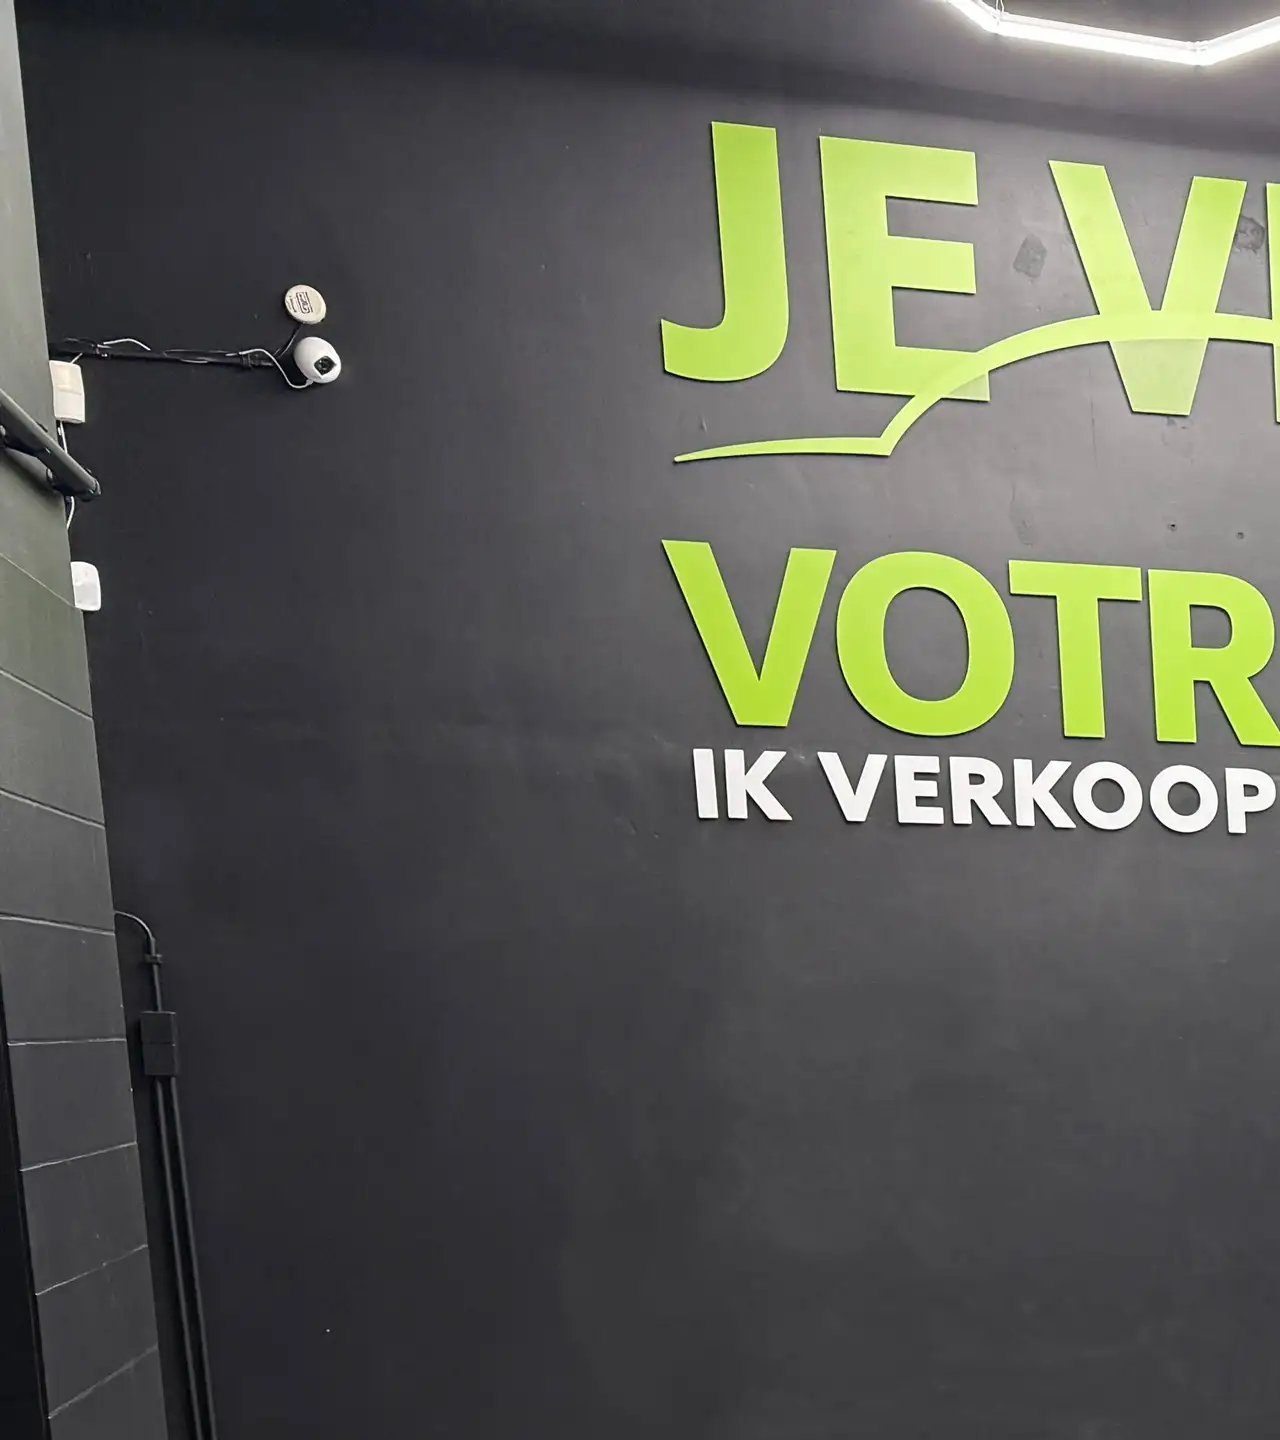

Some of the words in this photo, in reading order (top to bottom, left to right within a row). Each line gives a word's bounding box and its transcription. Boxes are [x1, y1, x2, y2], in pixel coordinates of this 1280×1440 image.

[660, 120, 991, 403] JE
[692, 748, 793, 822] IK
[816, 751, 1278, 834] VERKOOP
